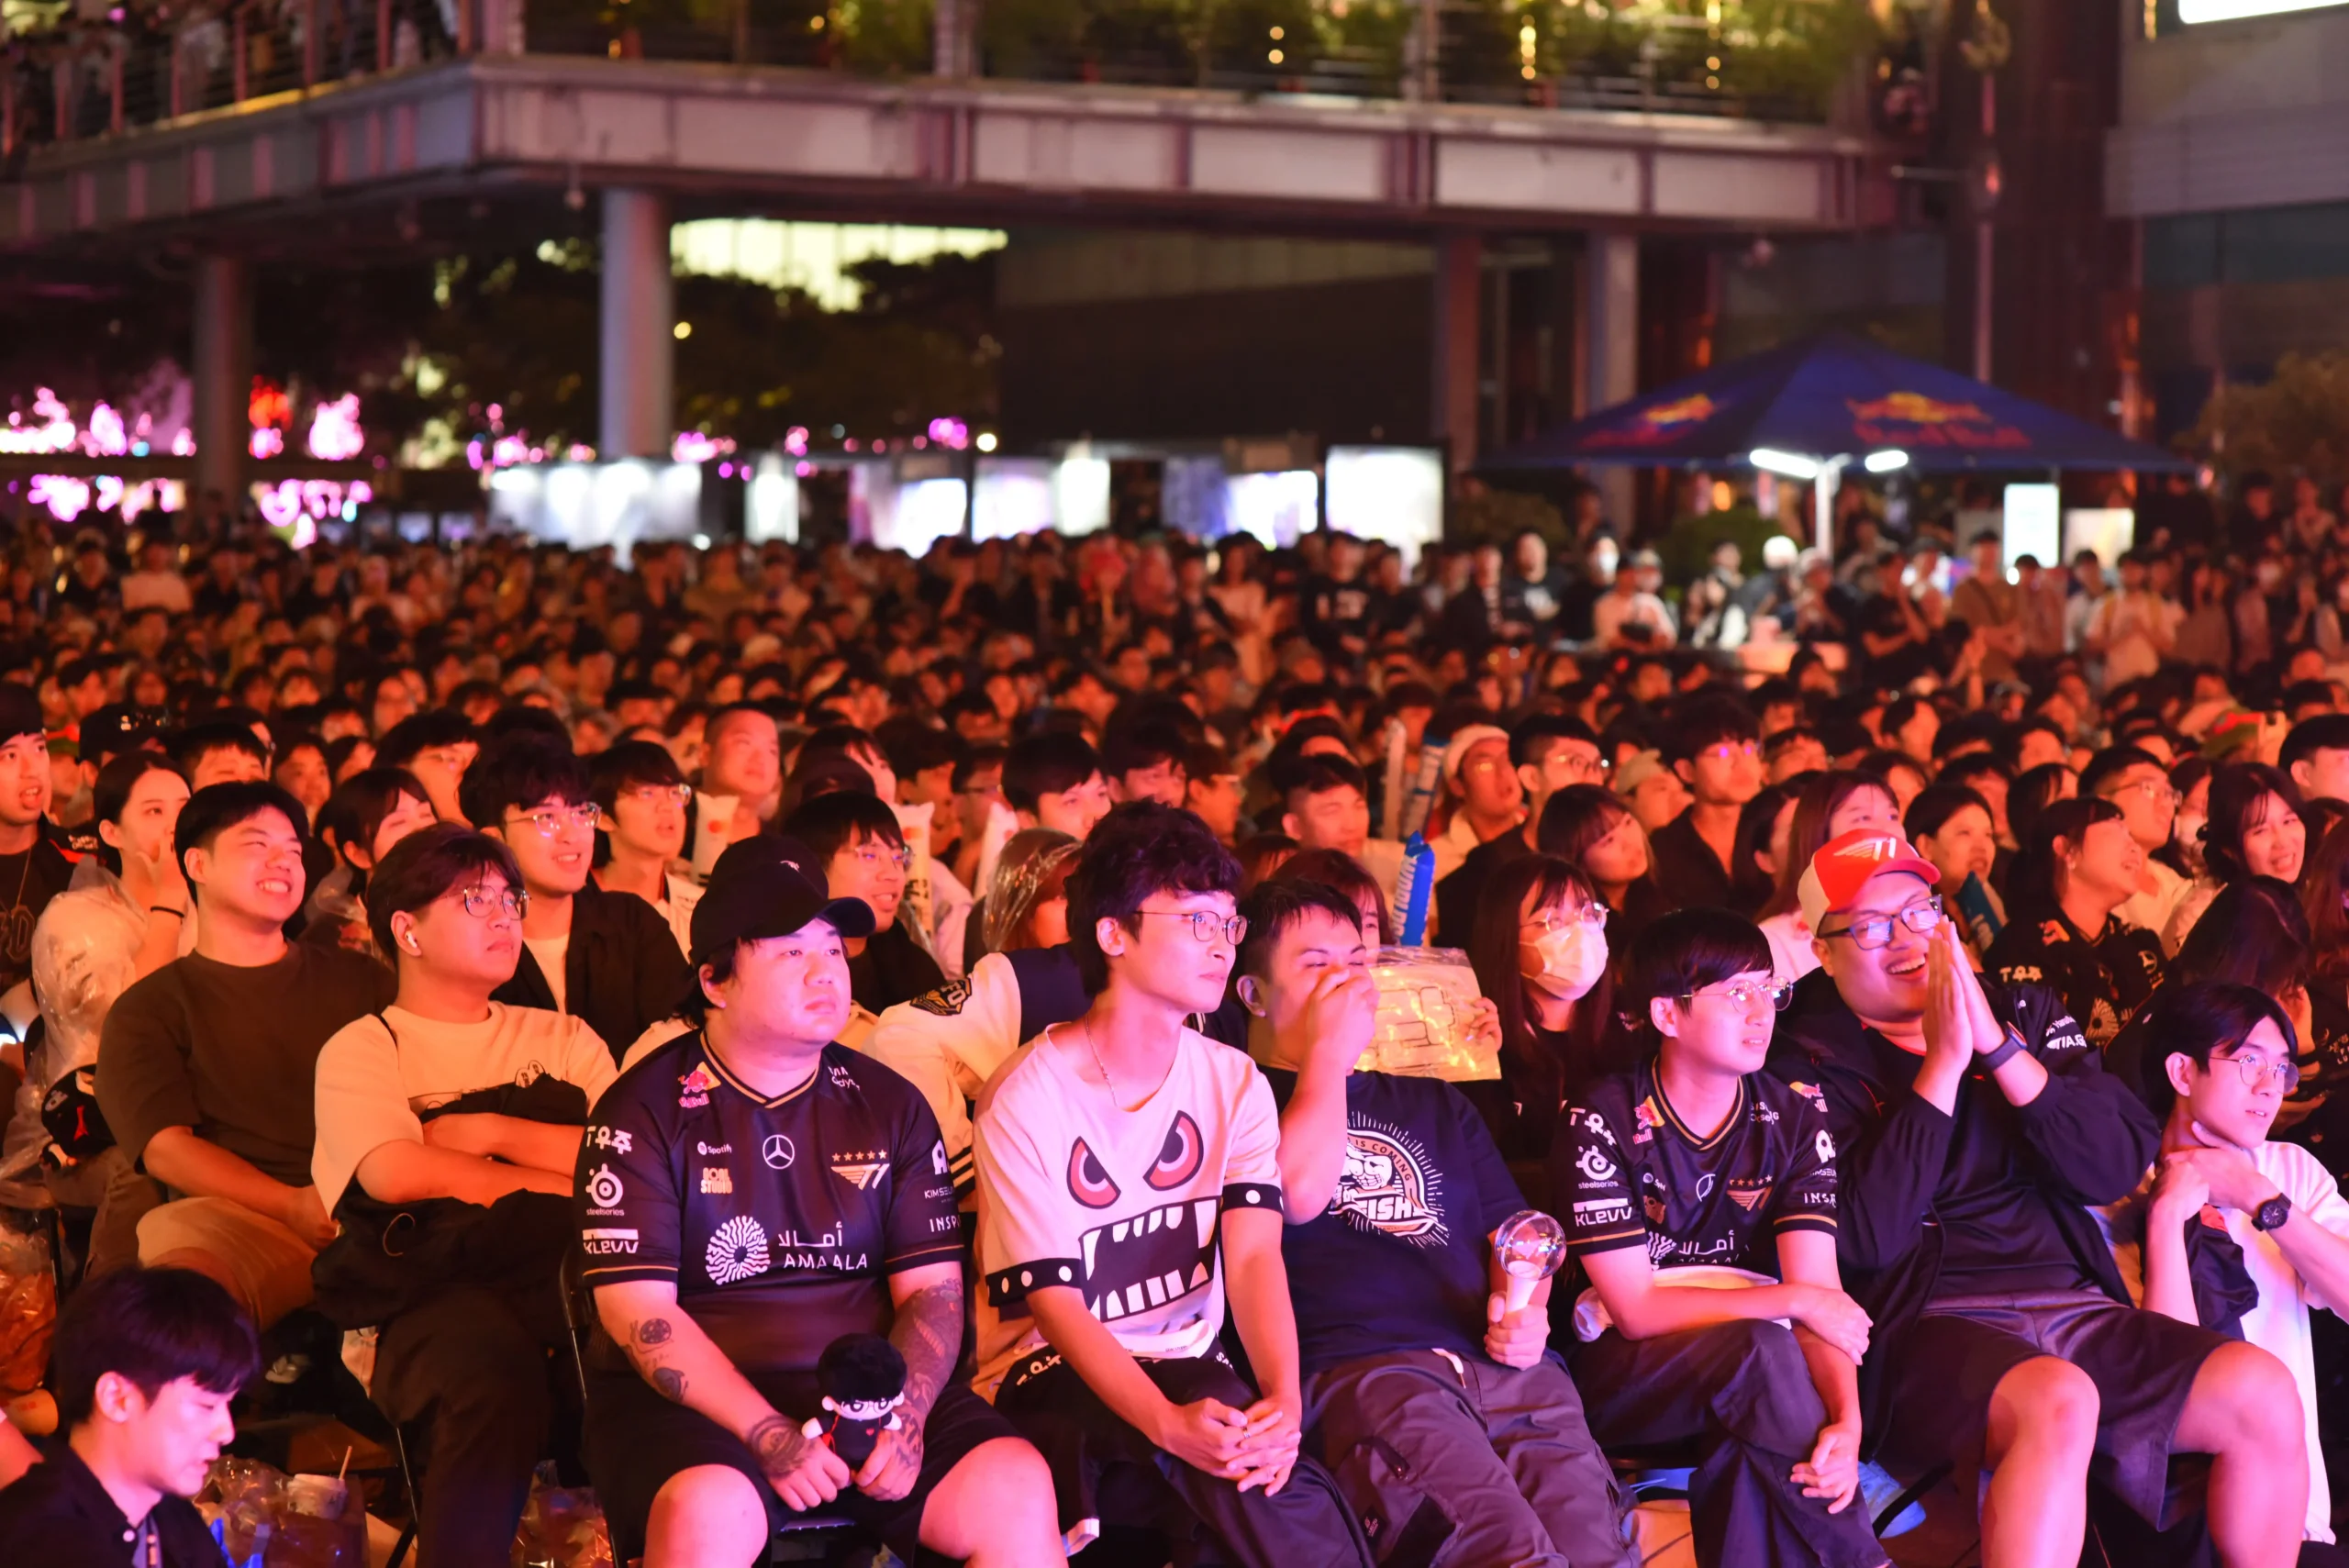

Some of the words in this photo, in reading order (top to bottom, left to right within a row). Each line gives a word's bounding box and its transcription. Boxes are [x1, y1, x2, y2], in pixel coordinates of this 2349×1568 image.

[1372, 1143, 1412, 1182] COMING
[700, 1180, 733, 1194] STUDIO
[1578, 1181, 1619, 1189] steelseries
[586, 1207, 625, 1217] steelseries
[784, 1253, 867, 1270] AMAALA
